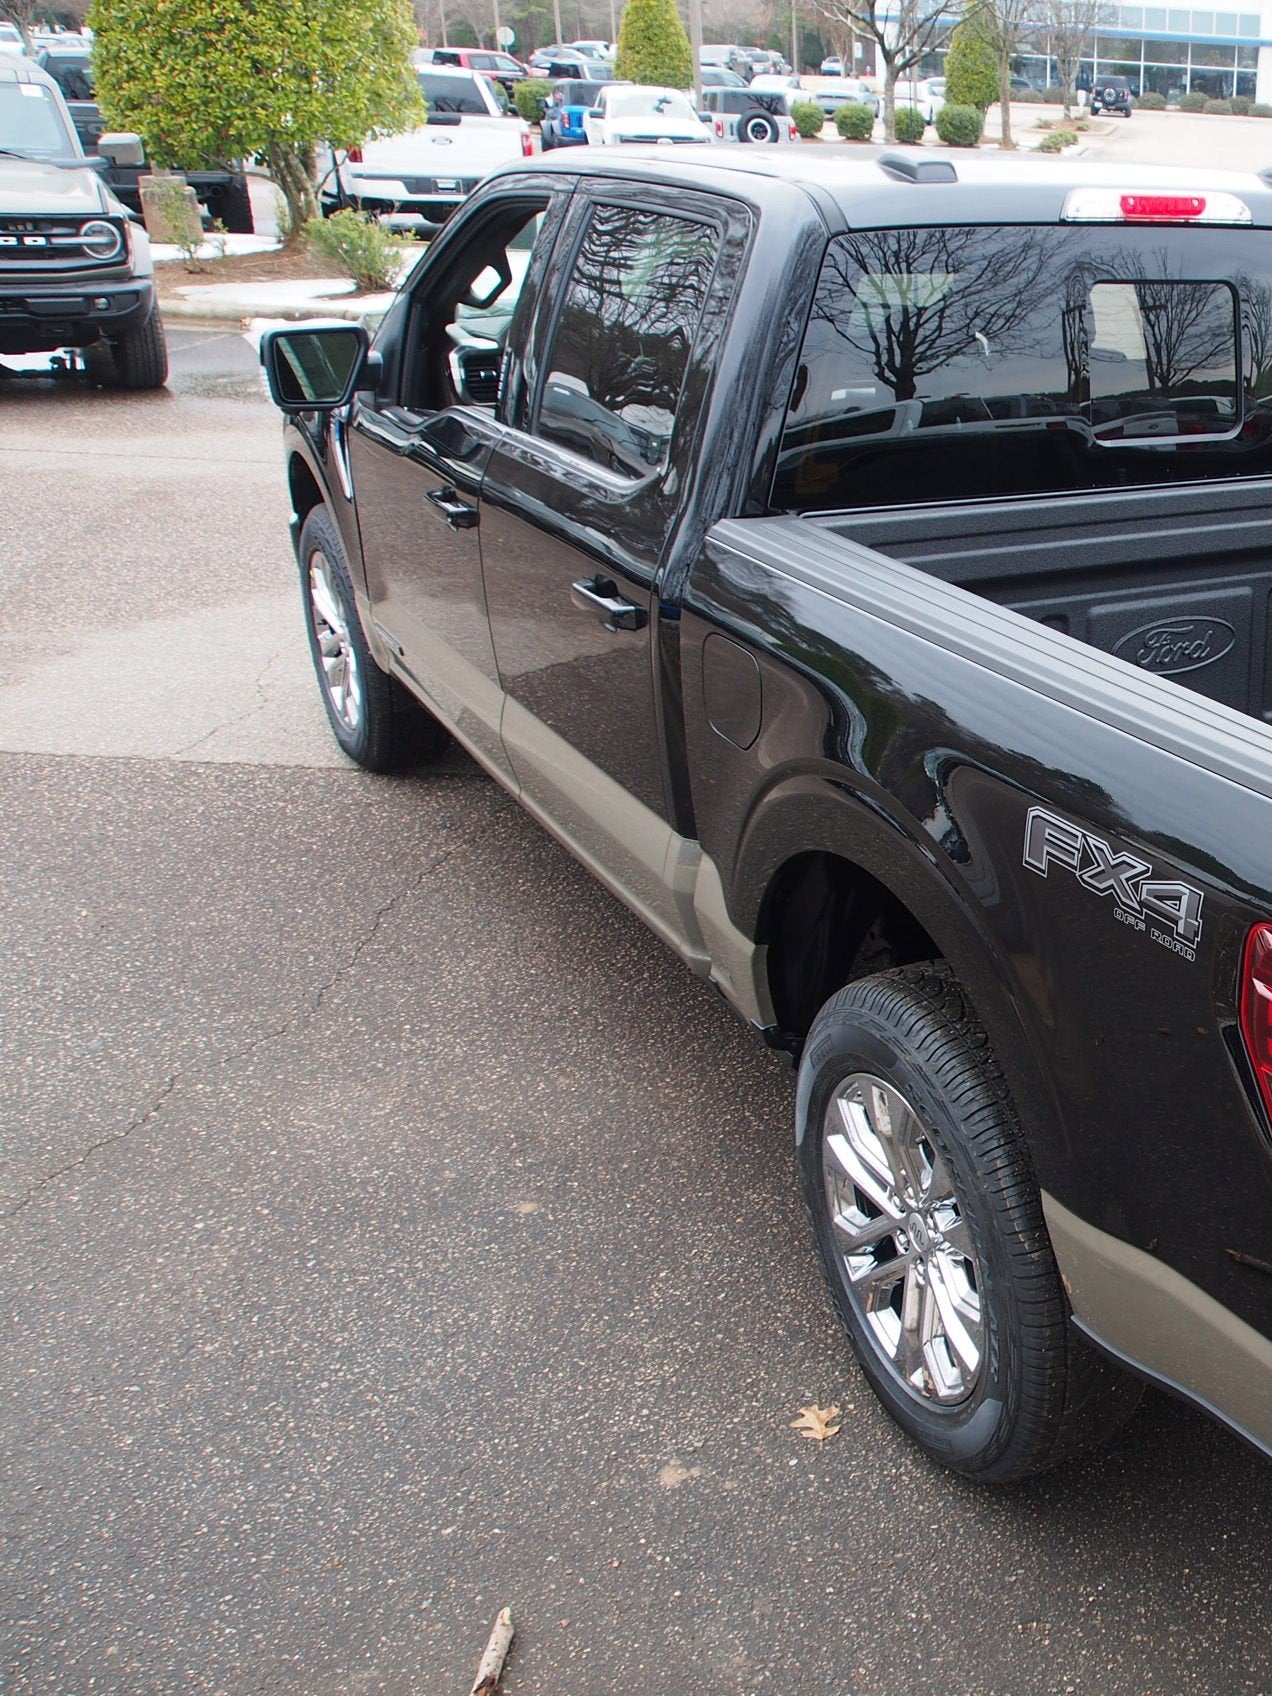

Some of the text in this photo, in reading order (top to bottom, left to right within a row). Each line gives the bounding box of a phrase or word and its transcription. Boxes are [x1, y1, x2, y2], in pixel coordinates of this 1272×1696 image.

[1136, 625, 1213, 666] Ford
[1022, 806, 1205, 949] FX4
[1114, 907, 1196, 962] OFF ROAD
